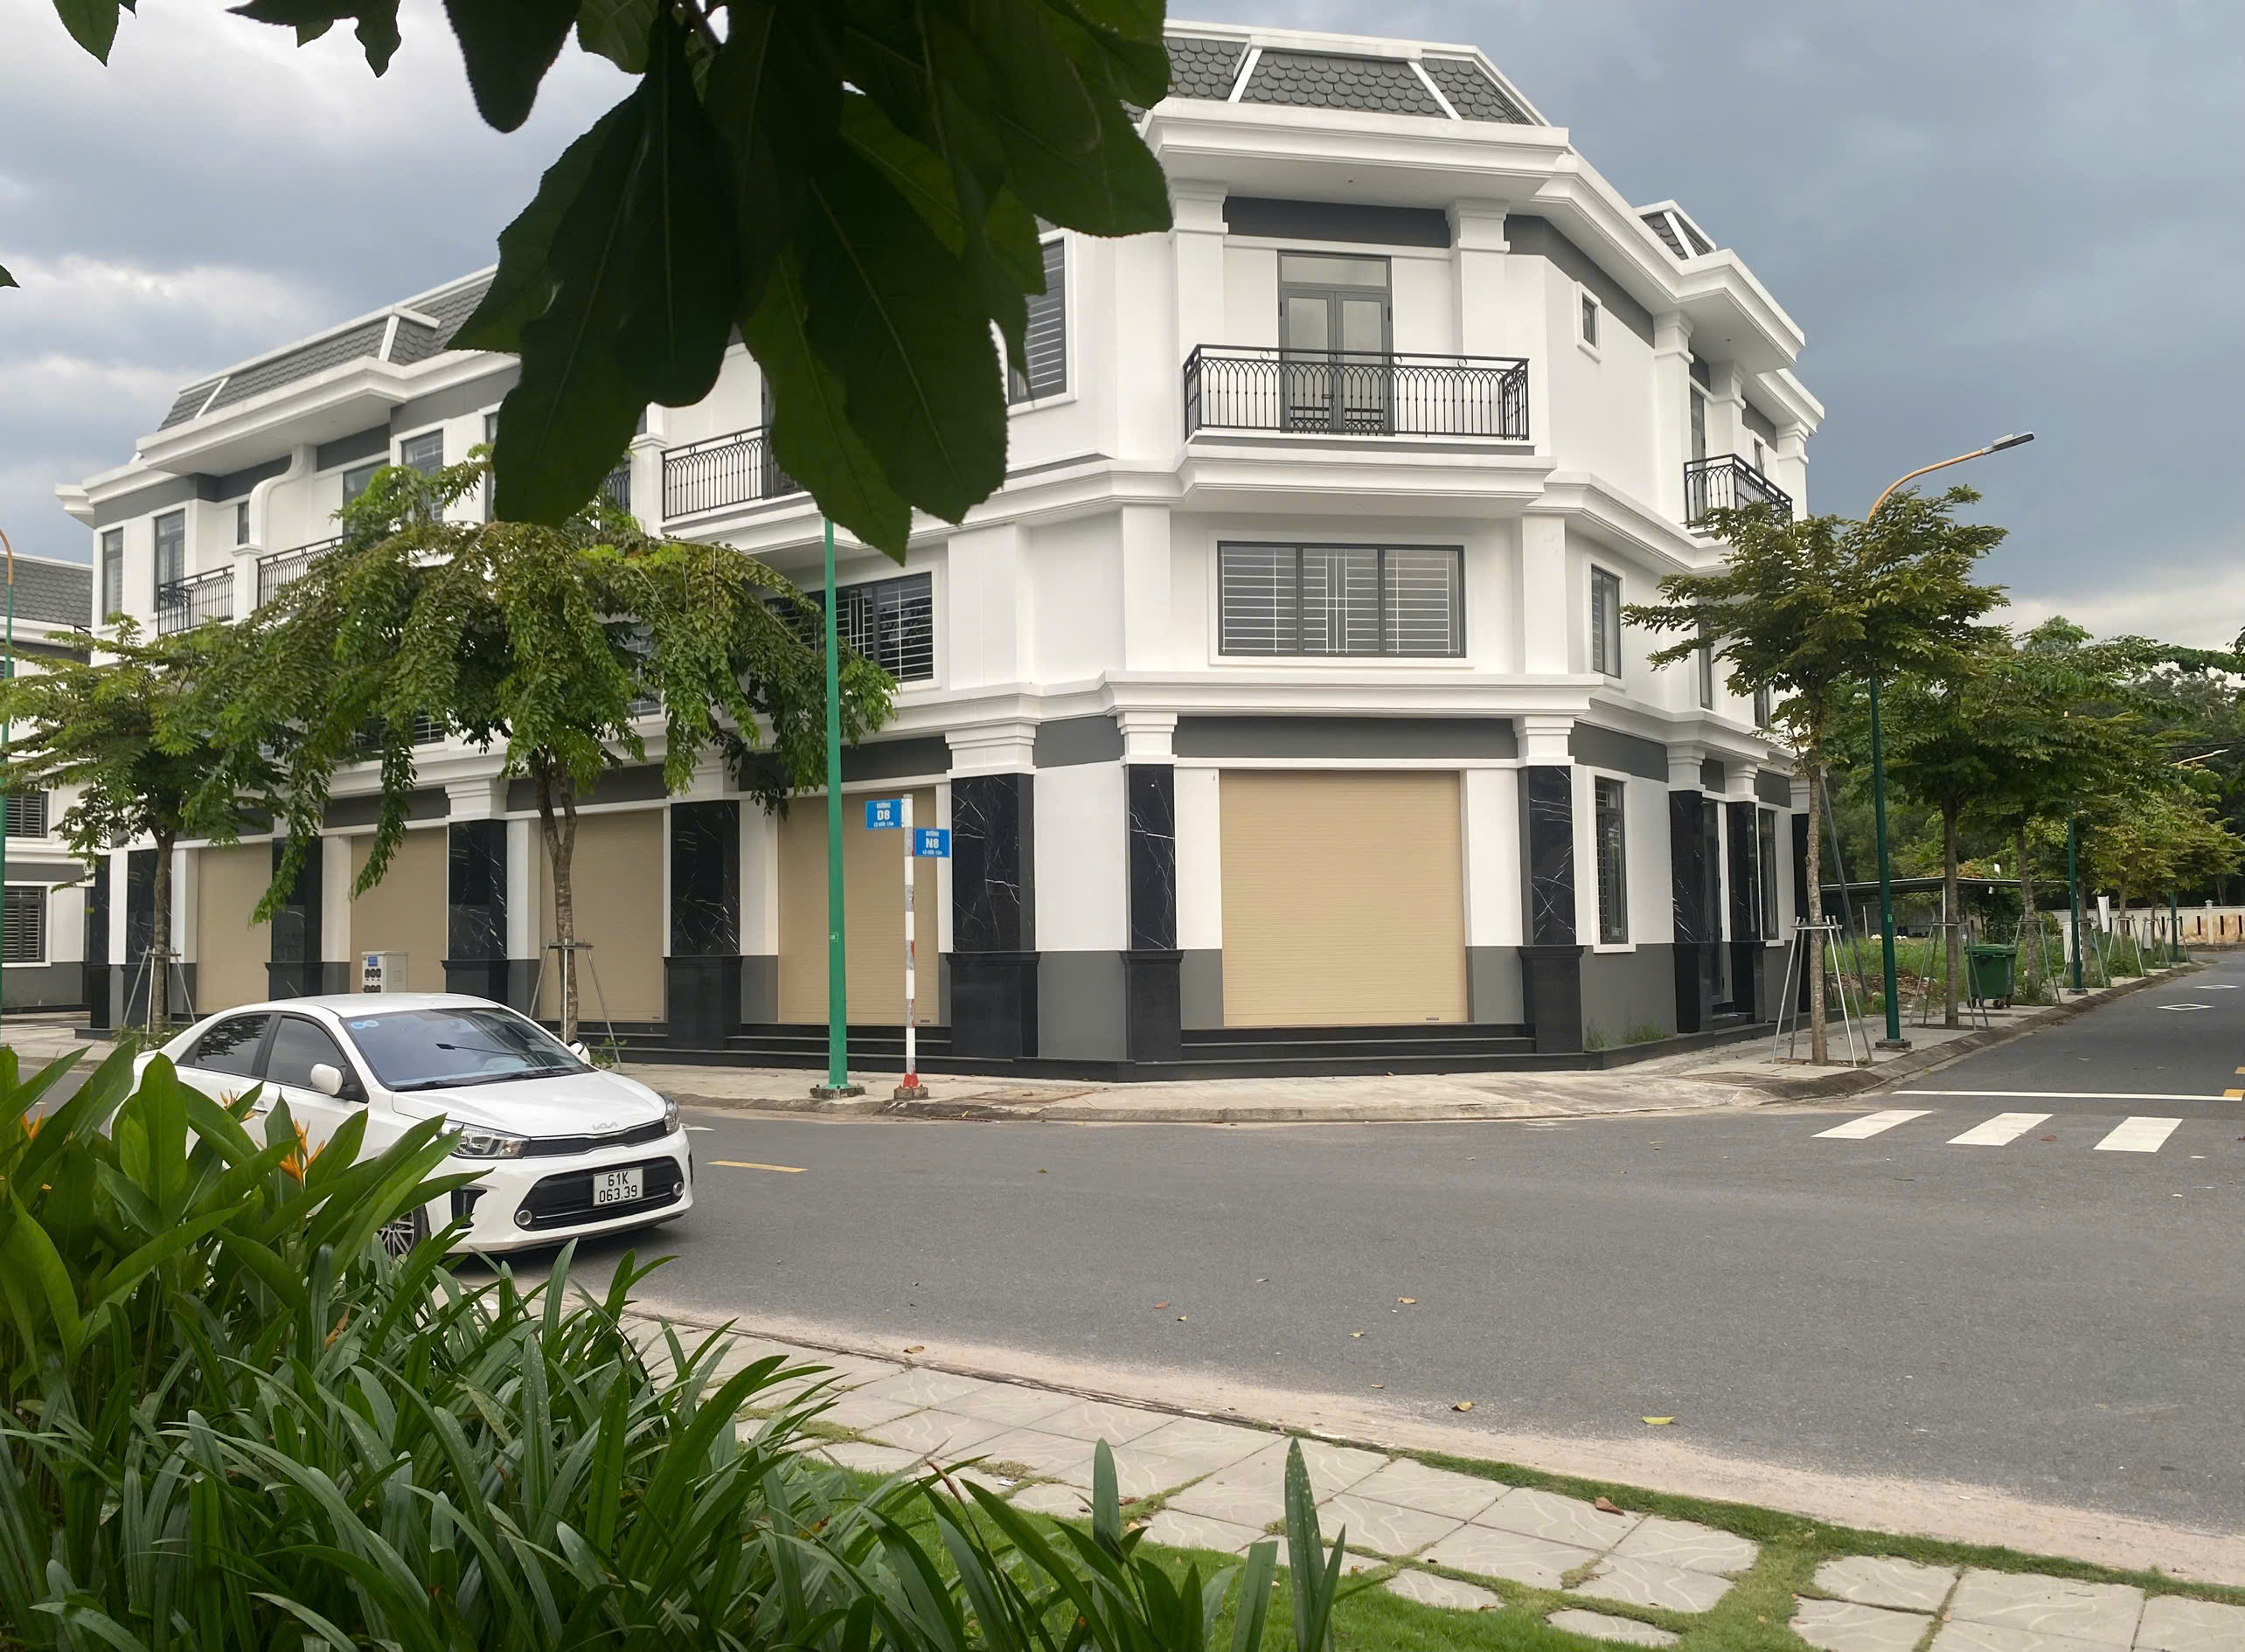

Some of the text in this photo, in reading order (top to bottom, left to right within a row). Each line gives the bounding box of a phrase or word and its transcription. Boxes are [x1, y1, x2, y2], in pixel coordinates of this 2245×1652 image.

[877, 809, 891, 822] D8
[925, 837, 940, 849] N8
[608, 1171, 629, 1187] 61K
[599, 1184, 637, 1203] 063.39
